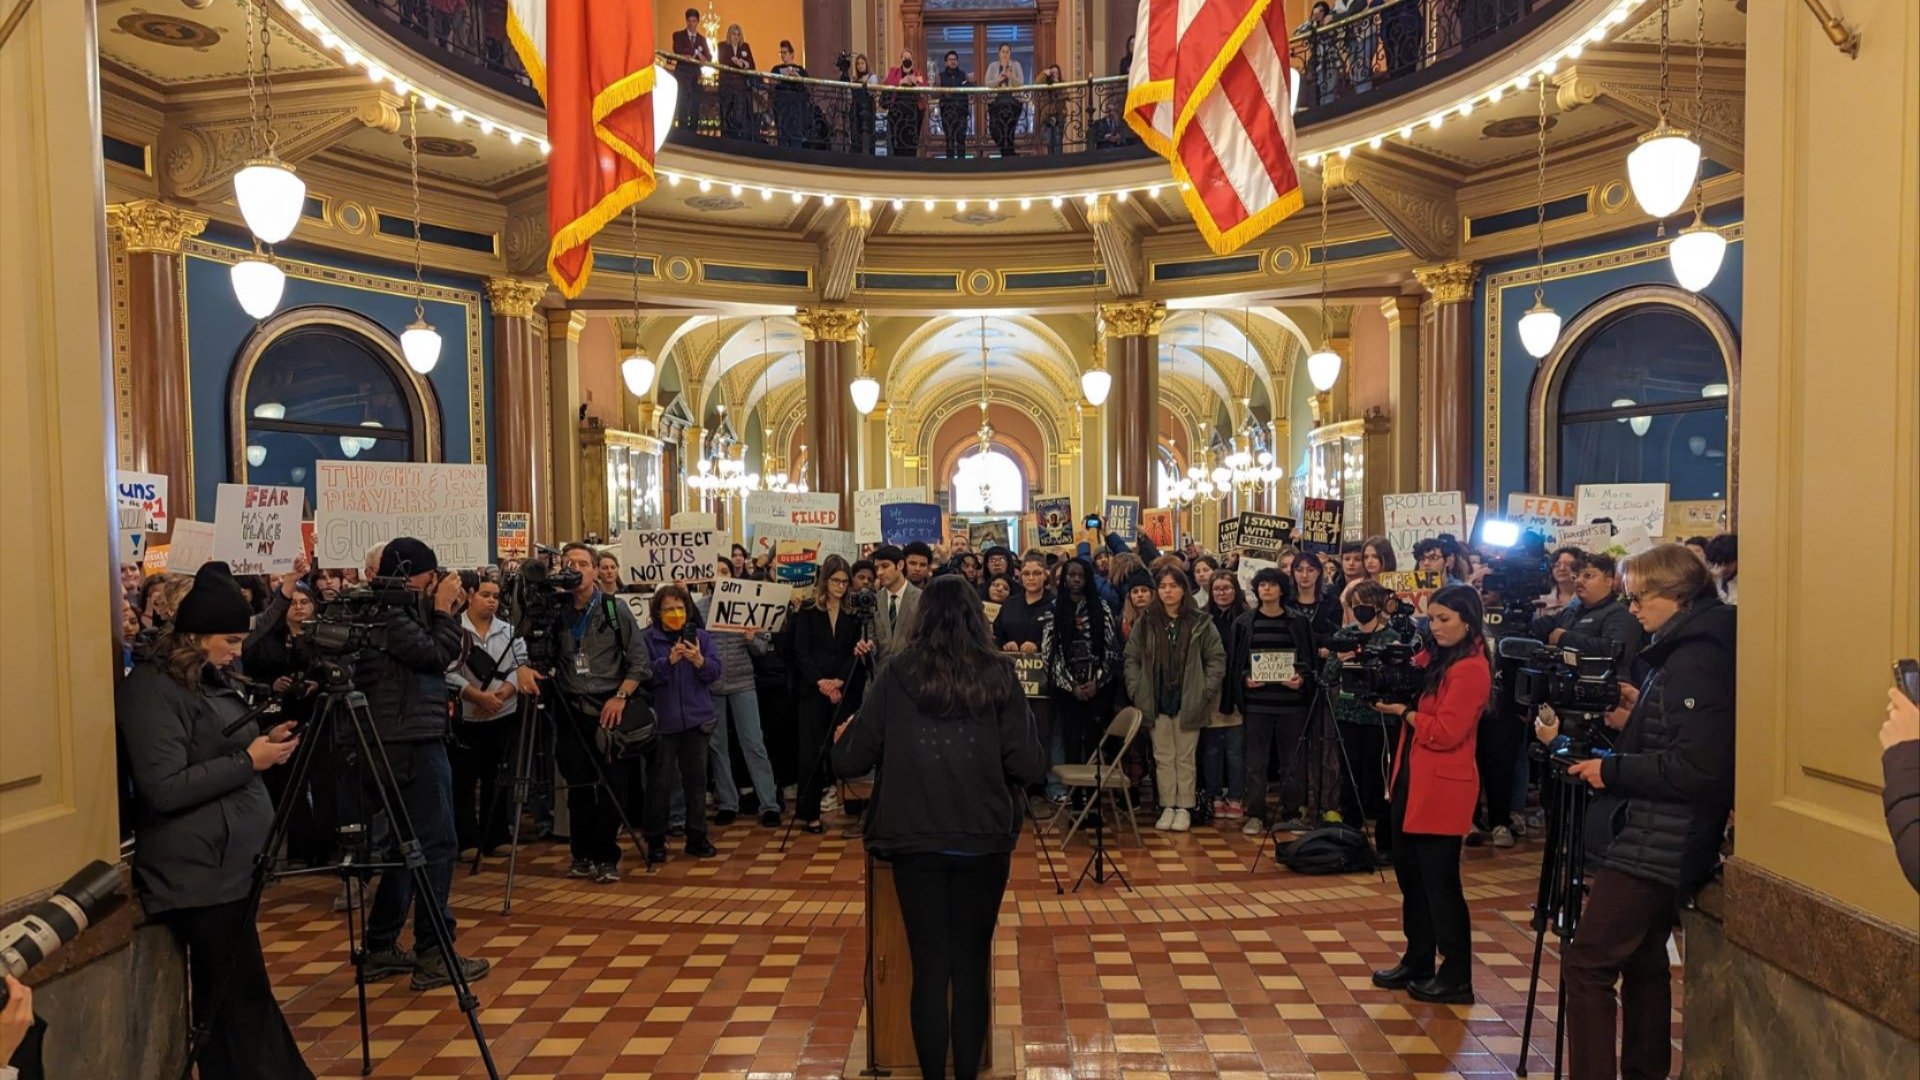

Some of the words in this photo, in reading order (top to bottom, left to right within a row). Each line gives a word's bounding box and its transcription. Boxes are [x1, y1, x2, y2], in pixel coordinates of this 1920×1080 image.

[119, 483, 155, 500] uns
[245, 487, 289, 508] FEAR
[1384, 493, 1458, 510] PROTECT
[1523, 499, 1575, 517] FEAR
[241, 511, 262, 524] HAS
[791, 510, 837, 526] KILLED
[1110, 504, 1133, 518] NOT
[1304, 510, 1321, 521] HAS
[1109, 517, 1131, 530] ONE
[1245, 515, 1249, 525] I
[1252, 516, 1289, 529] STAND
[1304, 520, 1328, 533] PLACE
[242, 521, 282, 541] PLACE
[887, 527, 934, 539] SAFETY
[1221, 534, 1237, 542] WIT
[1244, 526, 1274, 538] WITH
[639, 531, 713, 548] PROTECT
[1241, 536, 1279, 549] PERRY
[257, 541, 275, 555] MY
[649, 547, 696, 564] KIDS
[630, 563, 665, 582] NOT
[671, 563, 715, 581] GUNS
[1414, 571, 1439, 588] WE
[721, 581, 742, 594] am
[756, 583, 763, 597] i
[715, 600, 786, 631] NEXT?
